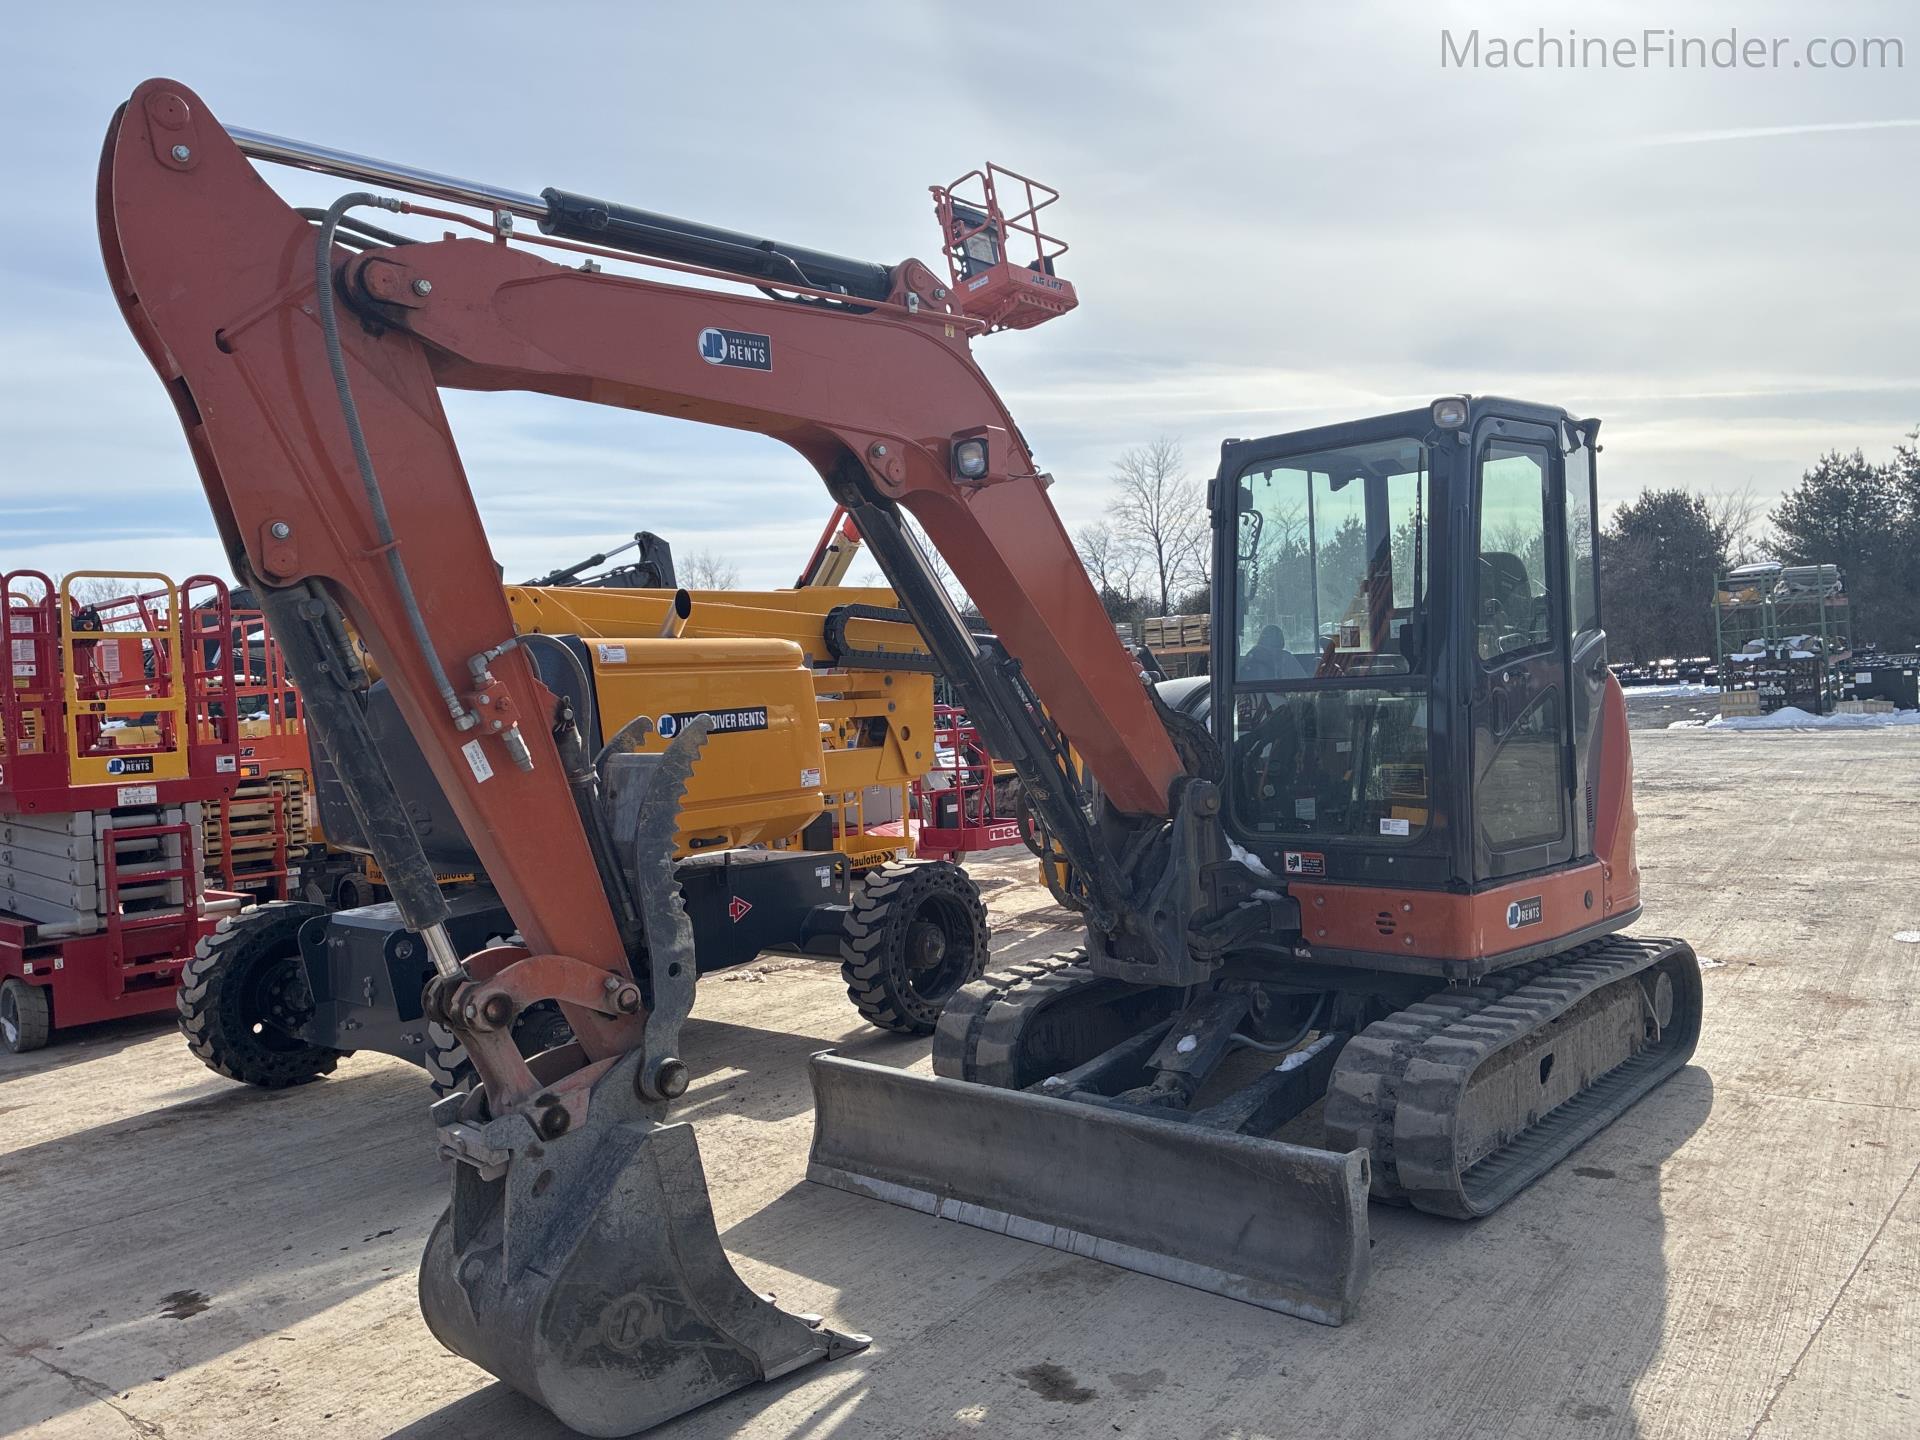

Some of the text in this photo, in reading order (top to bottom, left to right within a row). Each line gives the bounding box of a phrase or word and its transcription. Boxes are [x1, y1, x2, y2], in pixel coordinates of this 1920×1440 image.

[729, 345, 766, 363] RENTS
[711, 713, 737, 729] RIVER
[738, 711, 766, 727] RENTS
[126, 763, 150, 772] RENTS
[848, 854, 882, 868] Haulotte
[1521, 906, 1540, 921] RENTS
